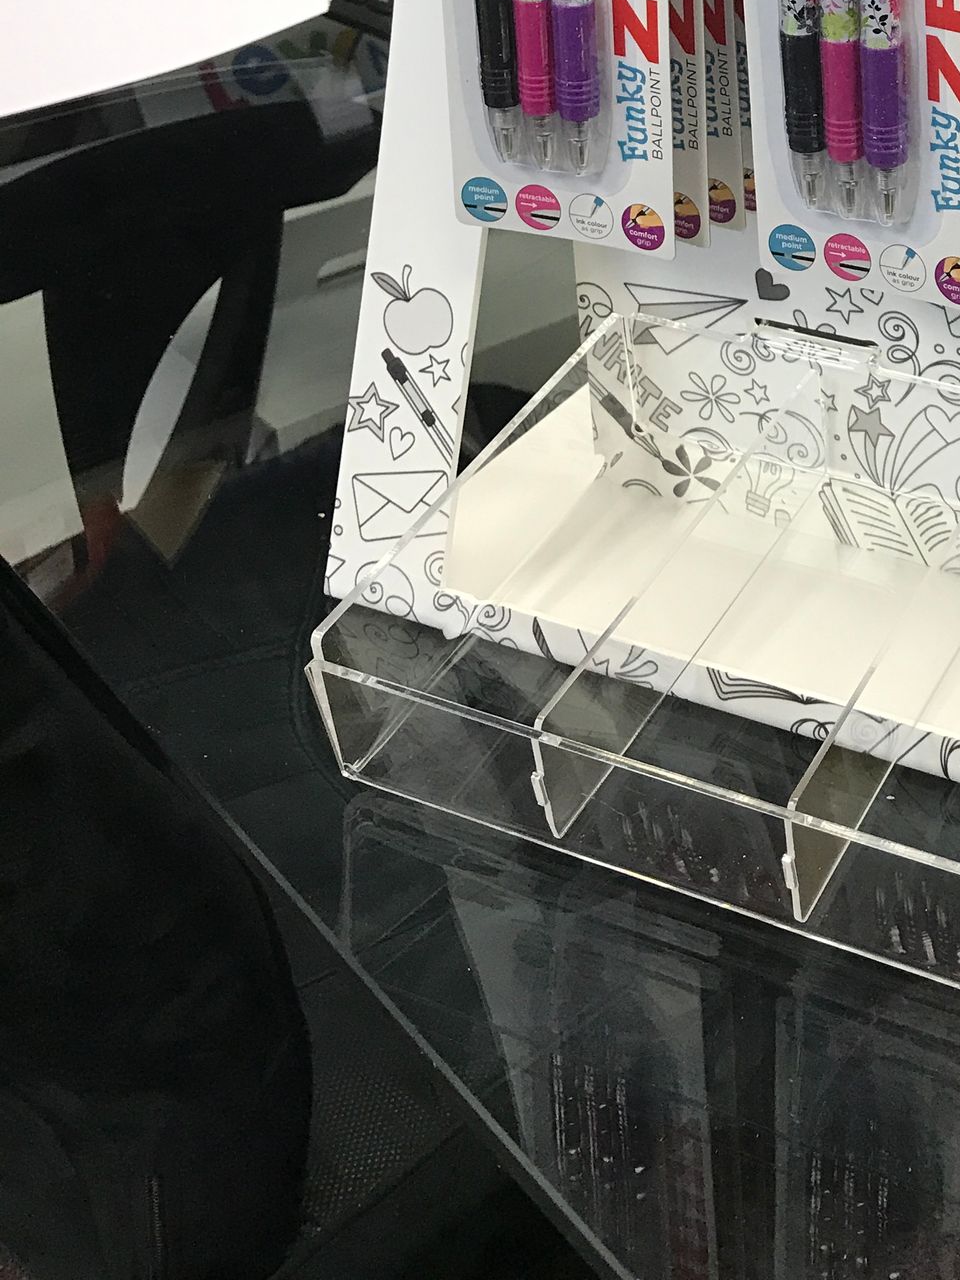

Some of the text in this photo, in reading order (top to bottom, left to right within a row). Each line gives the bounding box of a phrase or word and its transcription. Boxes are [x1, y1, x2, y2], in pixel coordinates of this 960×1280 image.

[717, 48, 733, 137] BALLPOINT
[685, 58, 699, 151] BALLPOINT
[616, 60, 649, 162] Funky
[649, 67, 664, 161] BALLPOINT
[468, 185, 500, 195] medium
[474, 193, 494, 202] point
[518, 192, 556, 204] retractable
[629, 228, 658, 242] comfort
[775, 232, 808, 244] medium
[636, 237, 652, 247] grip
[781, 241, 803, 251] point
[827, 241, 867, 255] retractable
[886, 269, 920, 282] ink colour
[900, 279, 915, 288] grip
